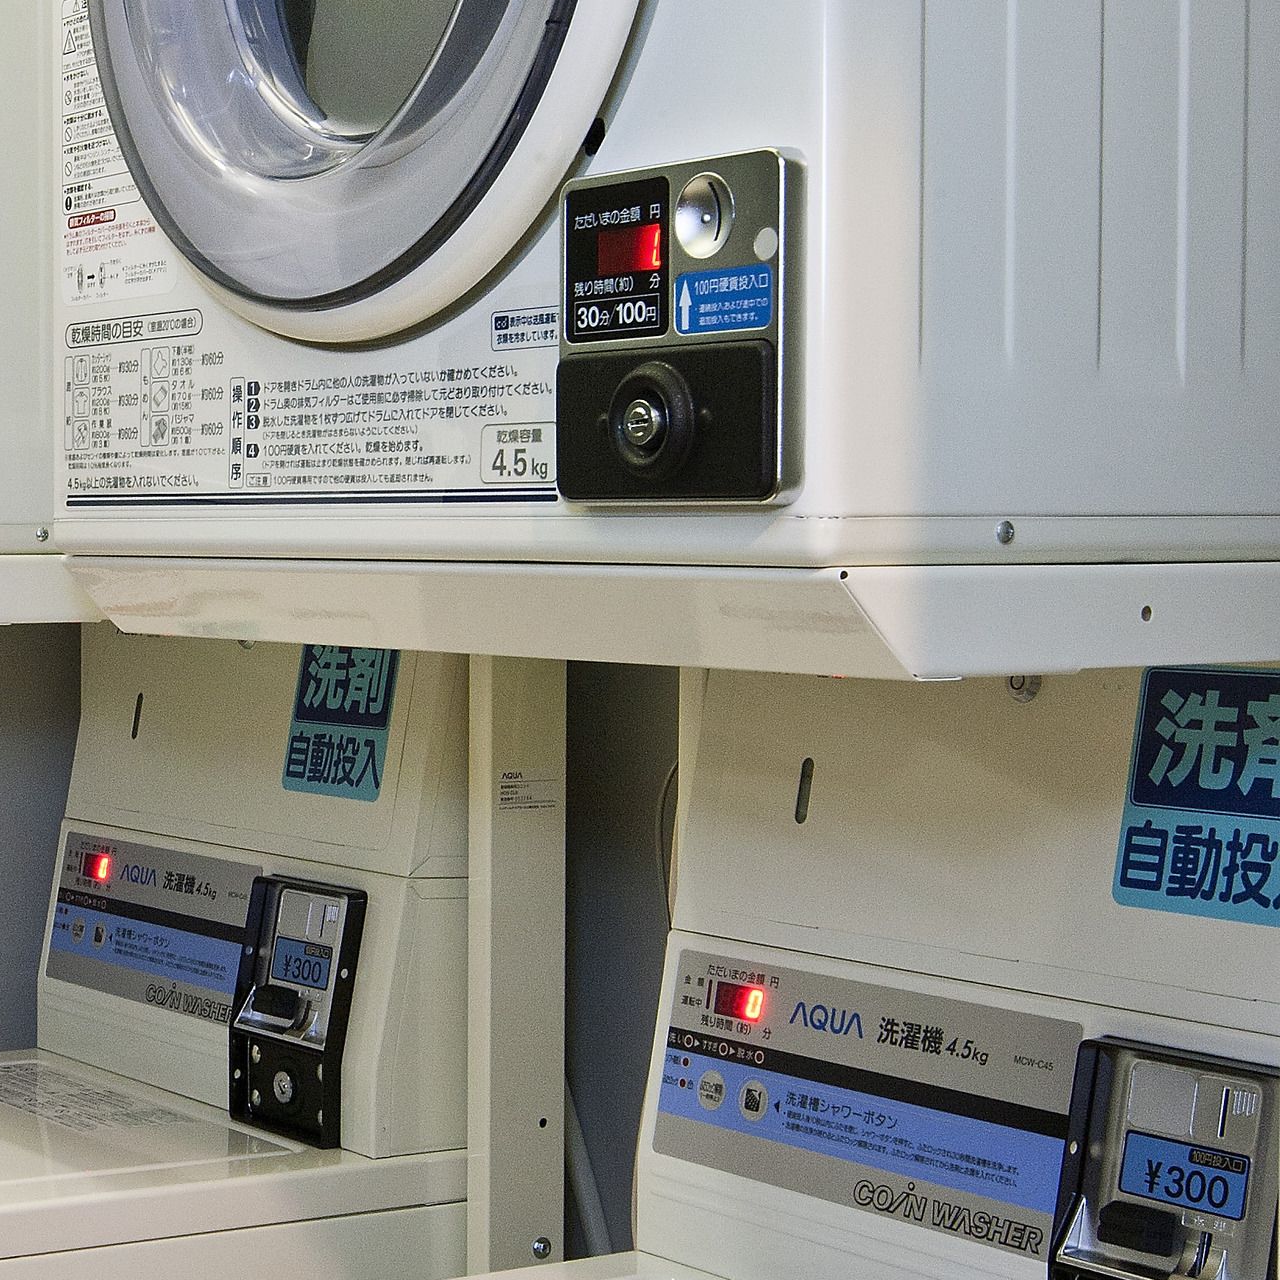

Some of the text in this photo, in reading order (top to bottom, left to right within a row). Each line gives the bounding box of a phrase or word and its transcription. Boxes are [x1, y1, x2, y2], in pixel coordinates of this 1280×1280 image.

[574, 203, 660, 230] ただいまの金額 円
[649, 273, 661, 290] 分
[694, 273, 769, 297] 100円硬貨投入口
[71, 320, 144, 344] 乾燥時間の目安
[231, 384, 243, 481] 操作順序
[496, 428, 543, 443] 乾燥容量
[303, 646, 391, 714] 洗剤
[286, 730, 380, 790] 自動投入
[120, 863, 157, 888] AQUA
[1119, 820, 1280, 910] 自動投
[162, 870, 195, 896] 洗濯機
[283, 954, 322, 984] ¥300
[707, 964, 780, 989] ただいまの金額 円
[745, 989, 764, 1019] 0
[761, 1027, 772, 1040] 分
[789, 1001, 863, 1039] AQUA
[877, 1016, 989, 1066] 洗濯機 4.5kg
[1013, 1054, 1054, 1071] MCW-C45
[785, 1091, 898, 1129] 洗濯槽シャワーボタン
[1144, 1159, 1230, 1209] ¥300
[932, 1199, 1043, 1255] WASHER
